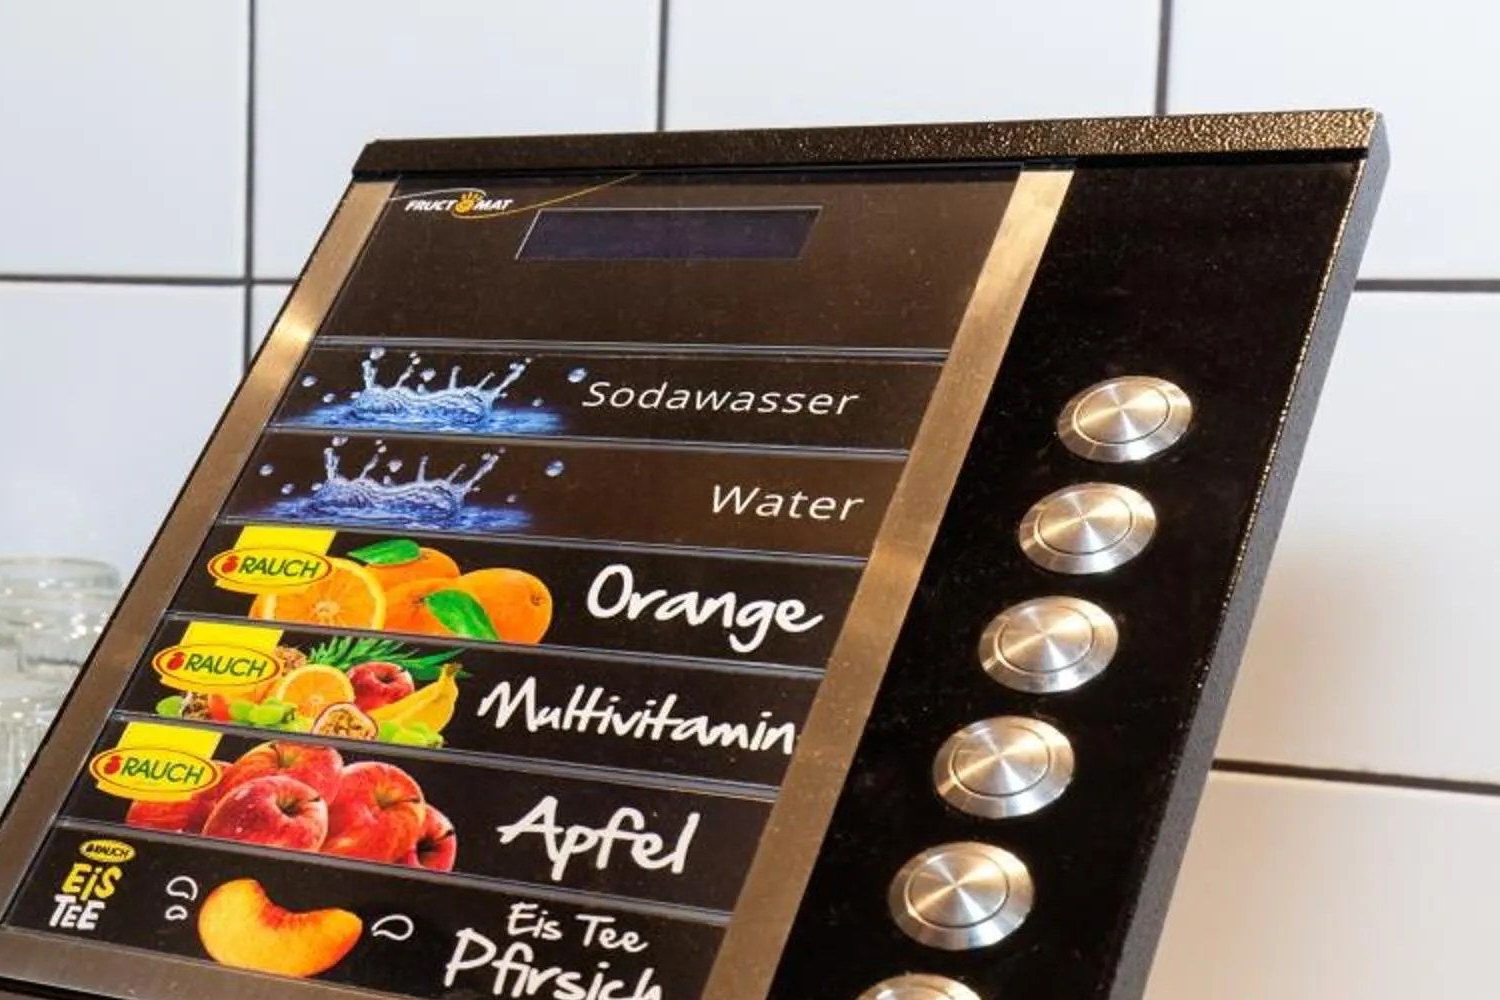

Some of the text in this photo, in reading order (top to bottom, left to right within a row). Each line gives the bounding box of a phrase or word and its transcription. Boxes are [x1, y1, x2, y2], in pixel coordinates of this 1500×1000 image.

[582, 381, 860, 417] Sodawasser
[711, 484, 865, 522] Water
[237, 555, 322, 581] RAUCH
[587, 563, 823, 653] Orange
[184, 653, 268, 680] RAUCH
[476, 676, 798, 756] Multivitamin
[122, 758, 205, 785] RAUCH
[497, 795, 702, 880] Apfel
[507, 903, 562, 942] Eis
[575, 913, 649, 953] Tee
